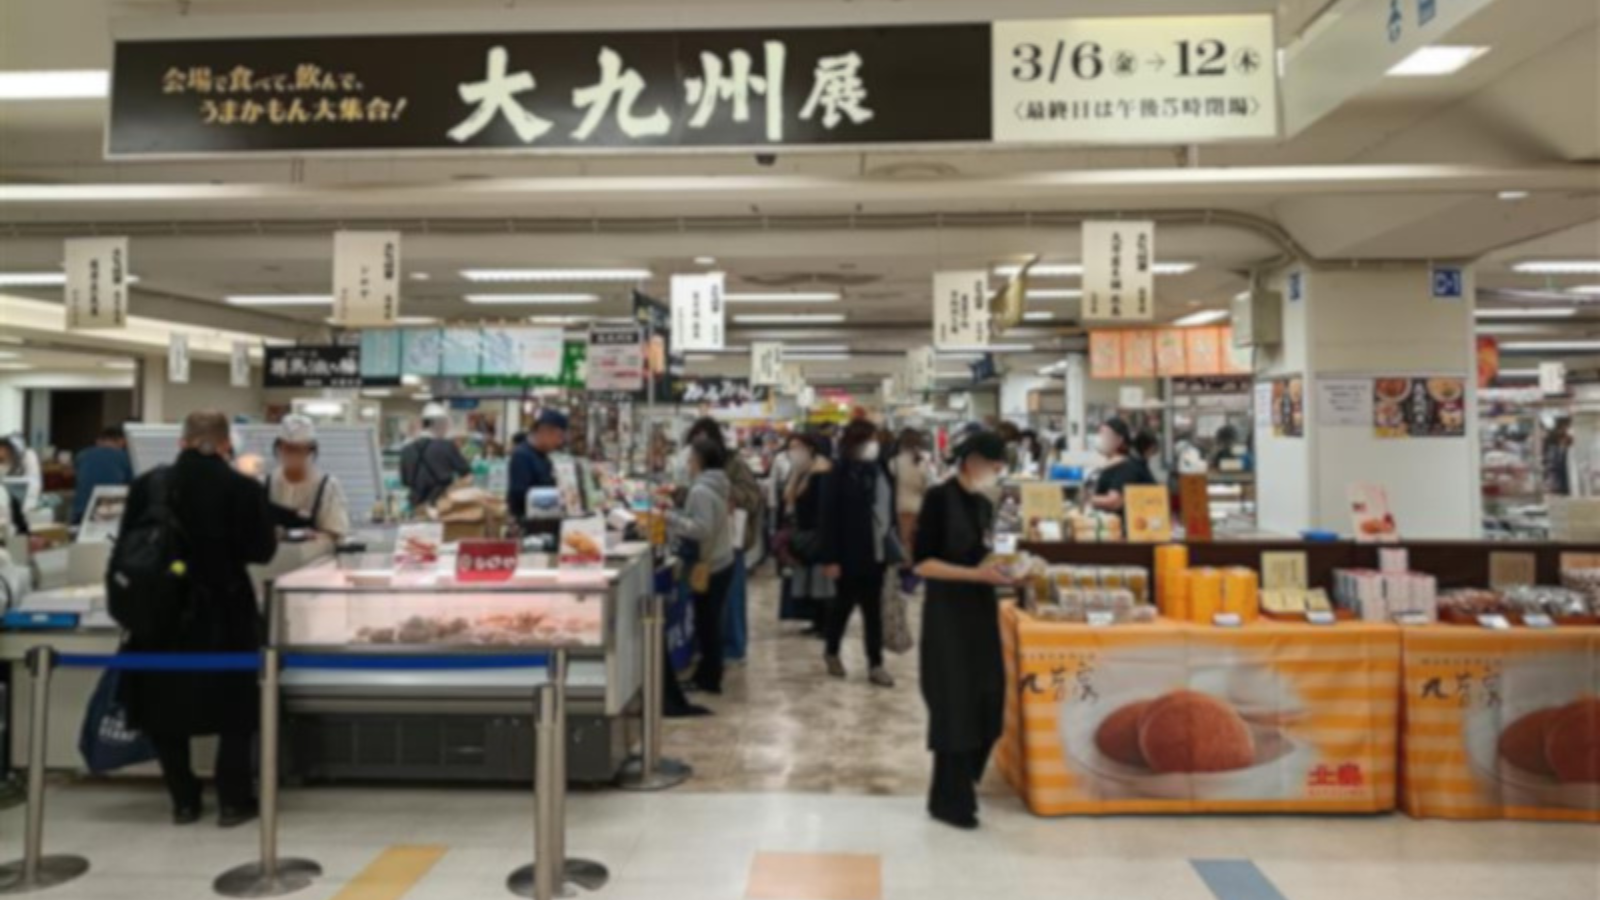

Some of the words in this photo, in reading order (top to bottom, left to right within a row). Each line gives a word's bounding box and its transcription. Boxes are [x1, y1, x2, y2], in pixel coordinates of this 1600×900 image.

[446, 40, 875, 143] 大九州展
[1011, 41, 1104, 83] 3/6
[1174, 39, 1227, 77] 12
